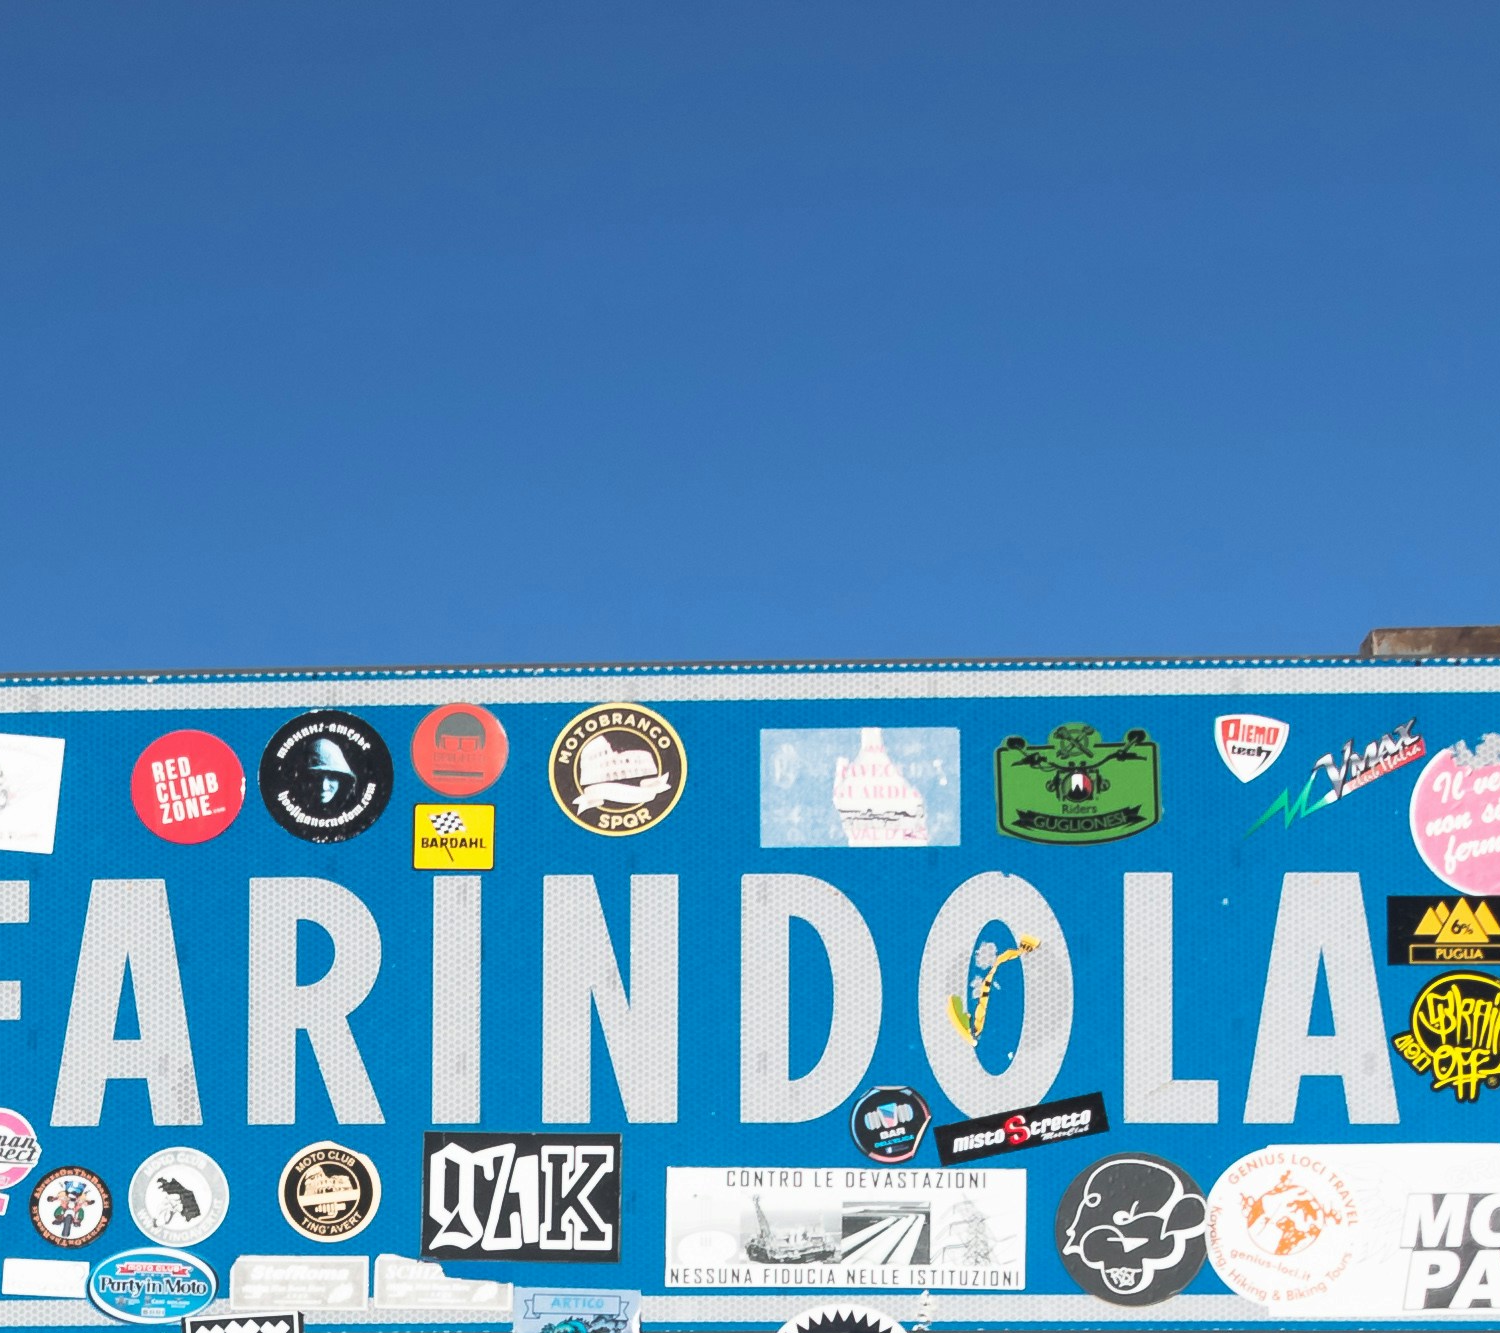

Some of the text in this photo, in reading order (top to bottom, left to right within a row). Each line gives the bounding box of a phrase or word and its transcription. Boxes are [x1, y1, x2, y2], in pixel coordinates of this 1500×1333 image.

[558, 712, 671, 764] MOTOBRANCO
[151, 756, 191, 783] RED
[156, 772, 219, 802] CLIMB
[598, 808, 652, 830] SPQR
[1061, 803, 1097, 816] Riders
[1032, 813, 1129, 832] GUGLIONESI
[1425, 813, 1472, 838] non
[421, 837, 487, 849] BARDAHL
[1436, 949, 1484, 959] PUGLIA
[880, 1127, 905, 1140] BAR
[295, 1151, 356, 1174] MOTO CLUB
[726, 1170, 987, 1189] CONTRO LE DEVASTAZIONI
[1228, 1152, 1358, 1227] GENIUS LOCI TRAVEL
[300, 1211, 363, 1234] TING'AVERT
[1230, 1248, 1311, 1281] genius-loci.it
[101, 1276, 207, 1296] Party in Moto
[670, 1268, 1020, 1287] NESSUNA FIDUCIA NELLE ISTITUZIONI
[1229, 1251, 1353, 1301] Hiking & Biking Tours
[551, 1296, 604, 1310] ARTICO
